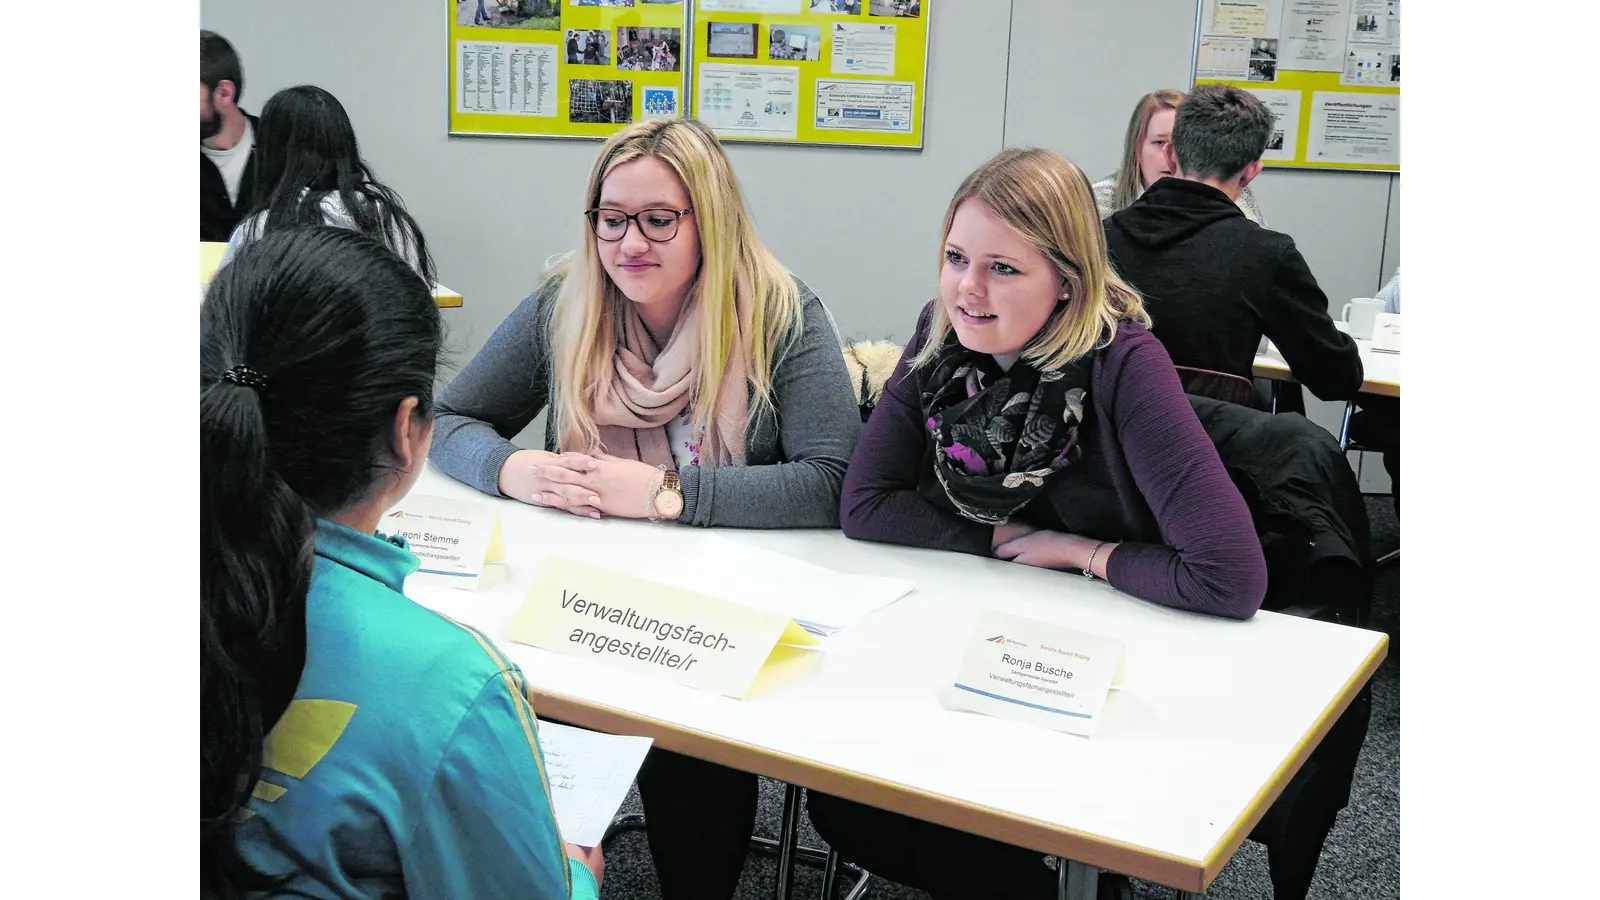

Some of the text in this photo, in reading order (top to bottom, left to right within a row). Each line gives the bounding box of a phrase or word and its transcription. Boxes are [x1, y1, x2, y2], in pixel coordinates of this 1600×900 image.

[423, 532, 459, 545] Stemme
[560, 589, 736, 652] Verwaltungsfach-
[568, 627, 698, 672] angestellte/r
[1001, 653, 1073, 679] Ronja Busche
